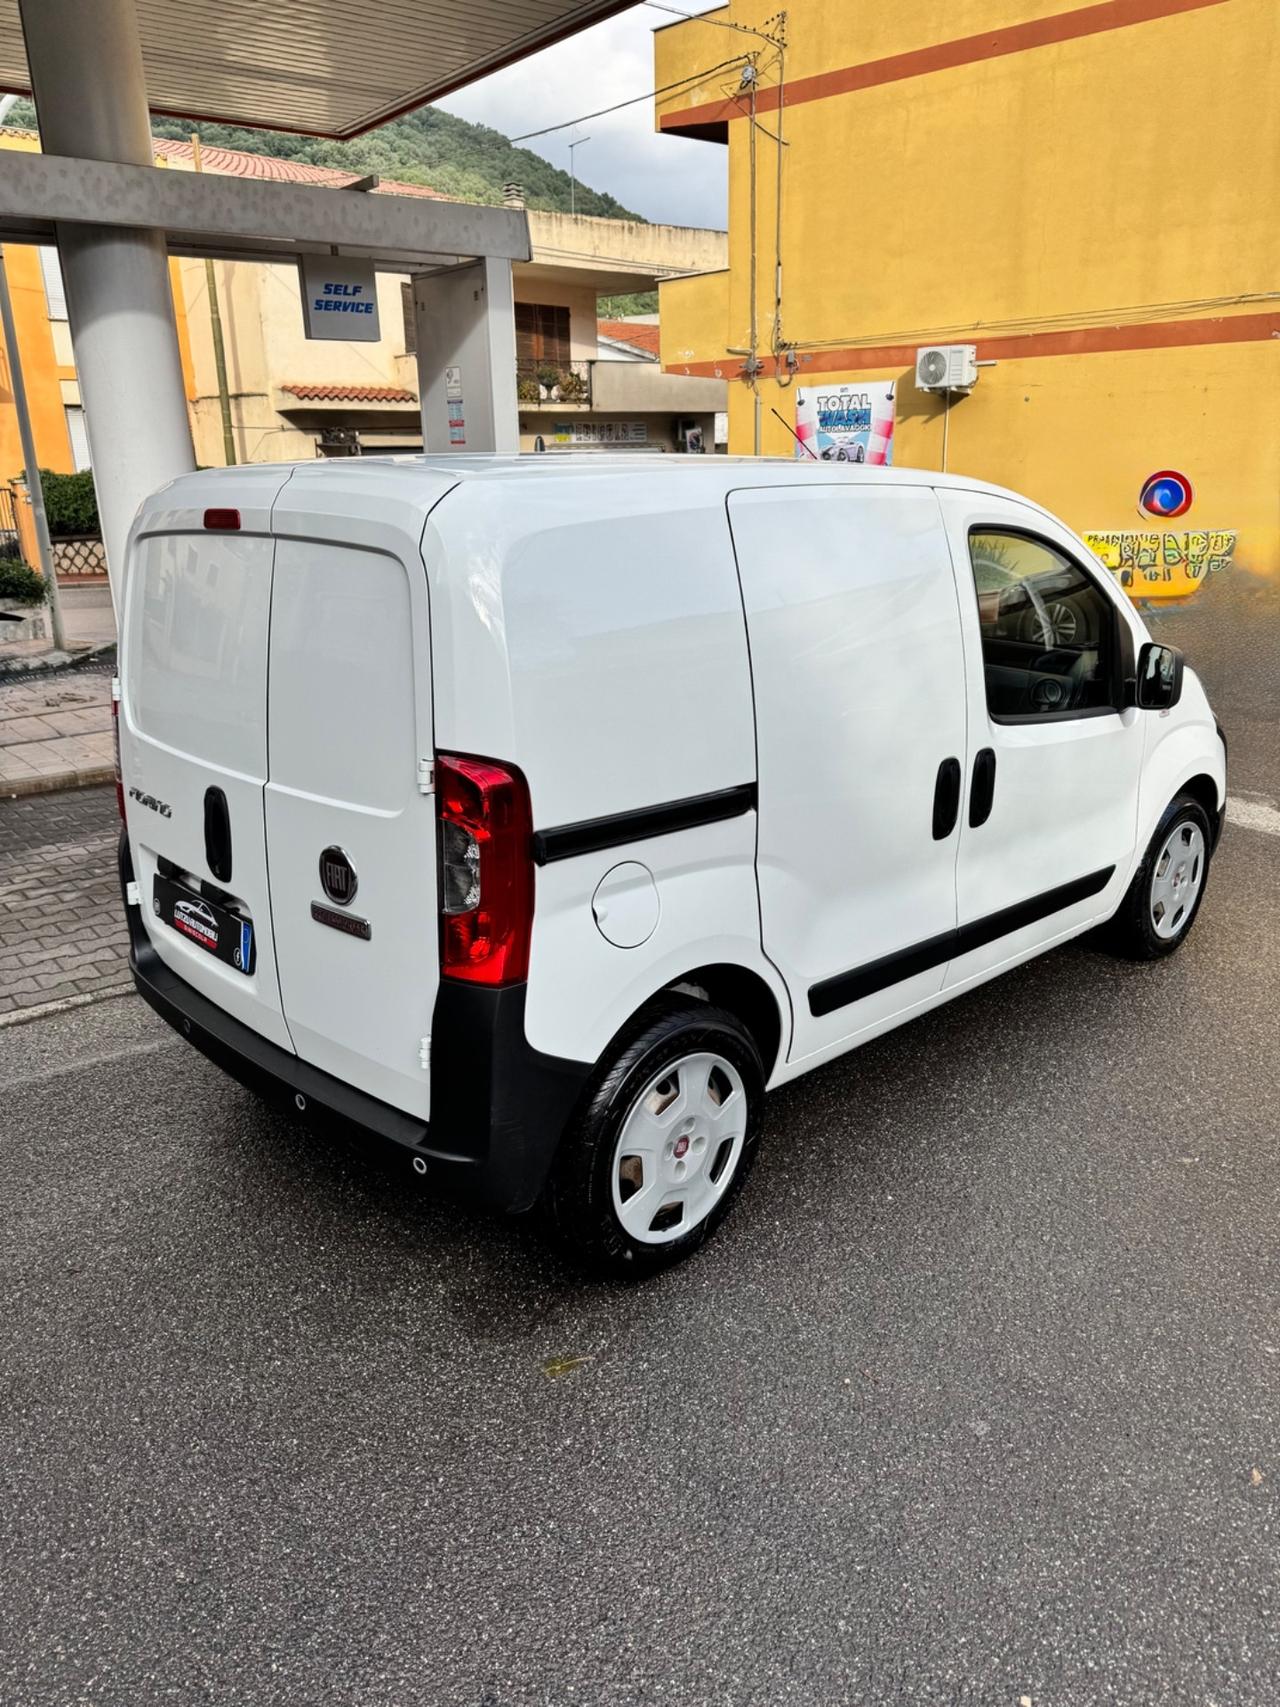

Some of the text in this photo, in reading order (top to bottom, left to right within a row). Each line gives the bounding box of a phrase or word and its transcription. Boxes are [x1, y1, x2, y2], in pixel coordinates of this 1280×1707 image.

[323, 283, 362, 297] SELF
[314, 299, 374, 314] SERVICE
[816, 393, 872, 412] TOTAL
[816, 409, 872, 427] WASH
[325, 861, 348, 891] FIAT
